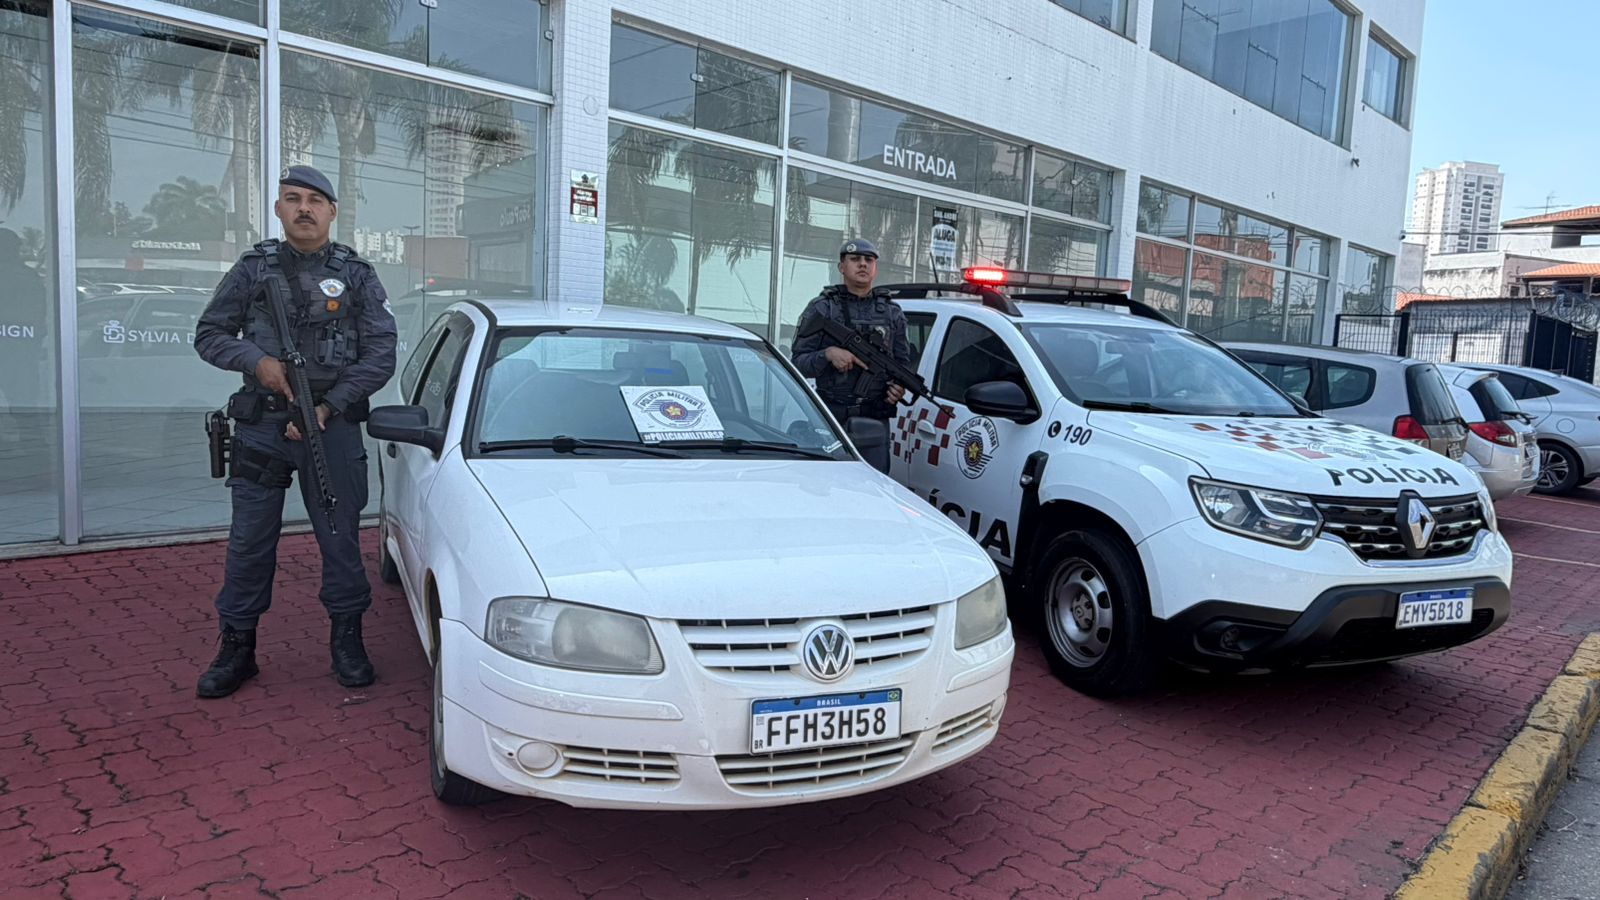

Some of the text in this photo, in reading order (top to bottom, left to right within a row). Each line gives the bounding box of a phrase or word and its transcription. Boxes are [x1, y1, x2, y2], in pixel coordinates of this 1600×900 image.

[883, 144, 957, 180] ENTRADA
[0, 325, 34, 338] IGN
[128, 329, 181, 343] SYLVIA
[667, 391, 698, 407] MILITAR
[643, 431, 724, 441] #POLICIAMILITARSP
[1063, 424, 1093, 446] 190
[1323, 463, 1460, 487] POLÍCIA
[1403, 601, 1464, 624] EMY5B18
[816, 698, 842, 707] BRASIL
[767, 707, 887, 747] FFH3H58
[754, 739, 764, 750] BR
